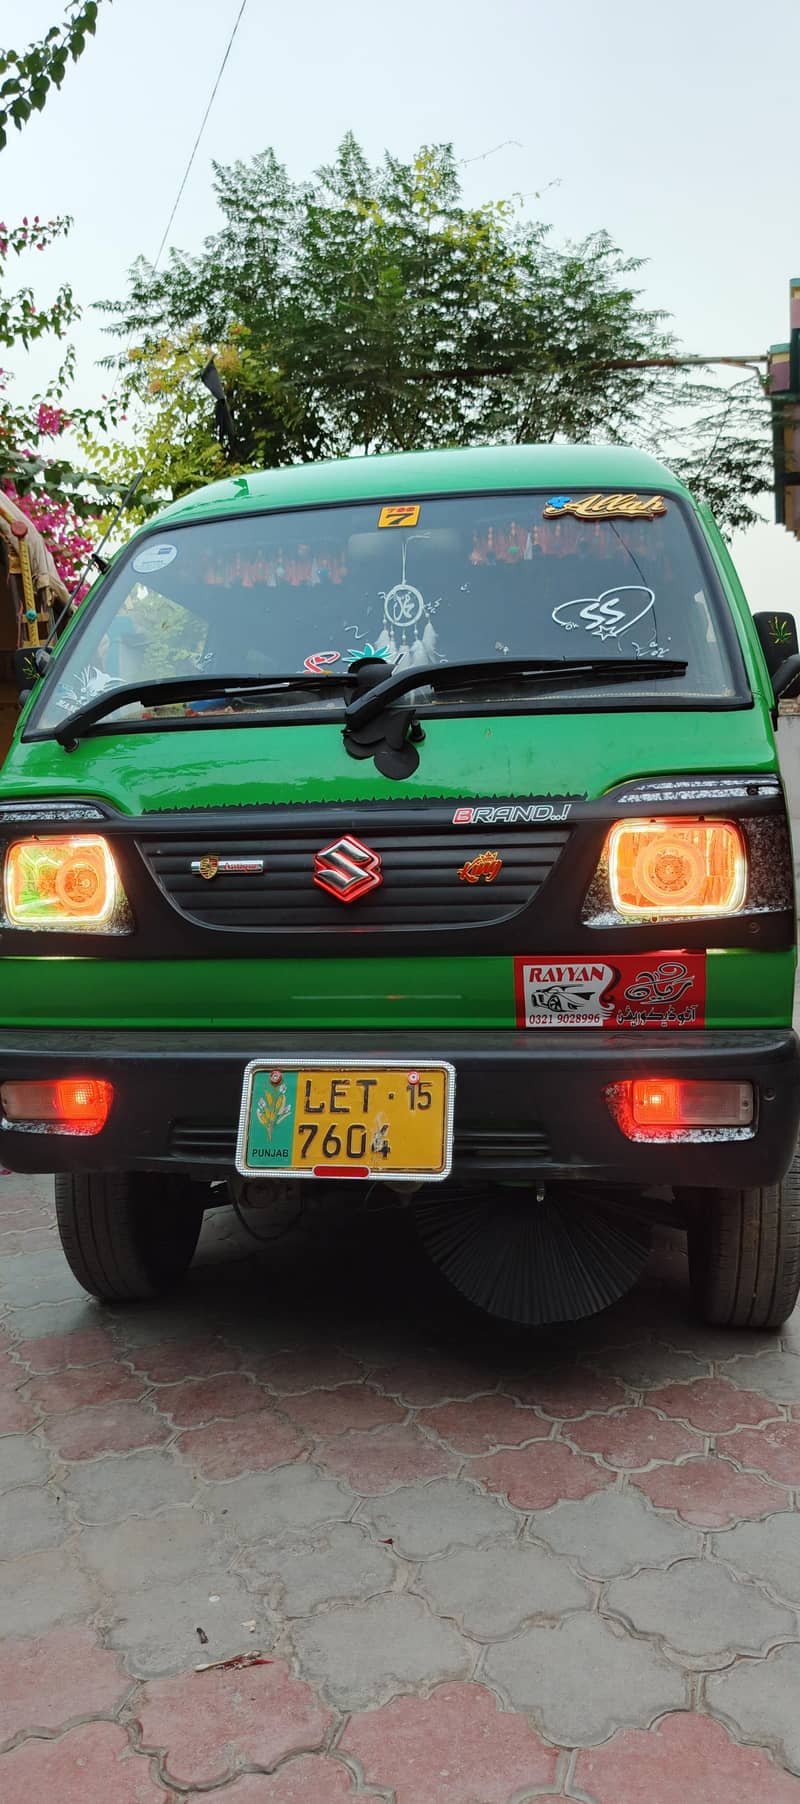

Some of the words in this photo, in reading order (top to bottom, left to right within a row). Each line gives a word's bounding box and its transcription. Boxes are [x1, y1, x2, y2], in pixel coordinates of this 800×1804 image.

[545, 494, 667, 519] Allah
[529, 966, 605, 983] RAYYAN
[529, 1014, 553, 1025] 0321
[557, 1013, 600, 1024] 9028996
[304, 1079, 377, 1113] LET
[406, 1082, 432, 1111] 15
[298, 1124, 391, 1160] 7604
[252, 1149, 289, 1158] PUNJAB
